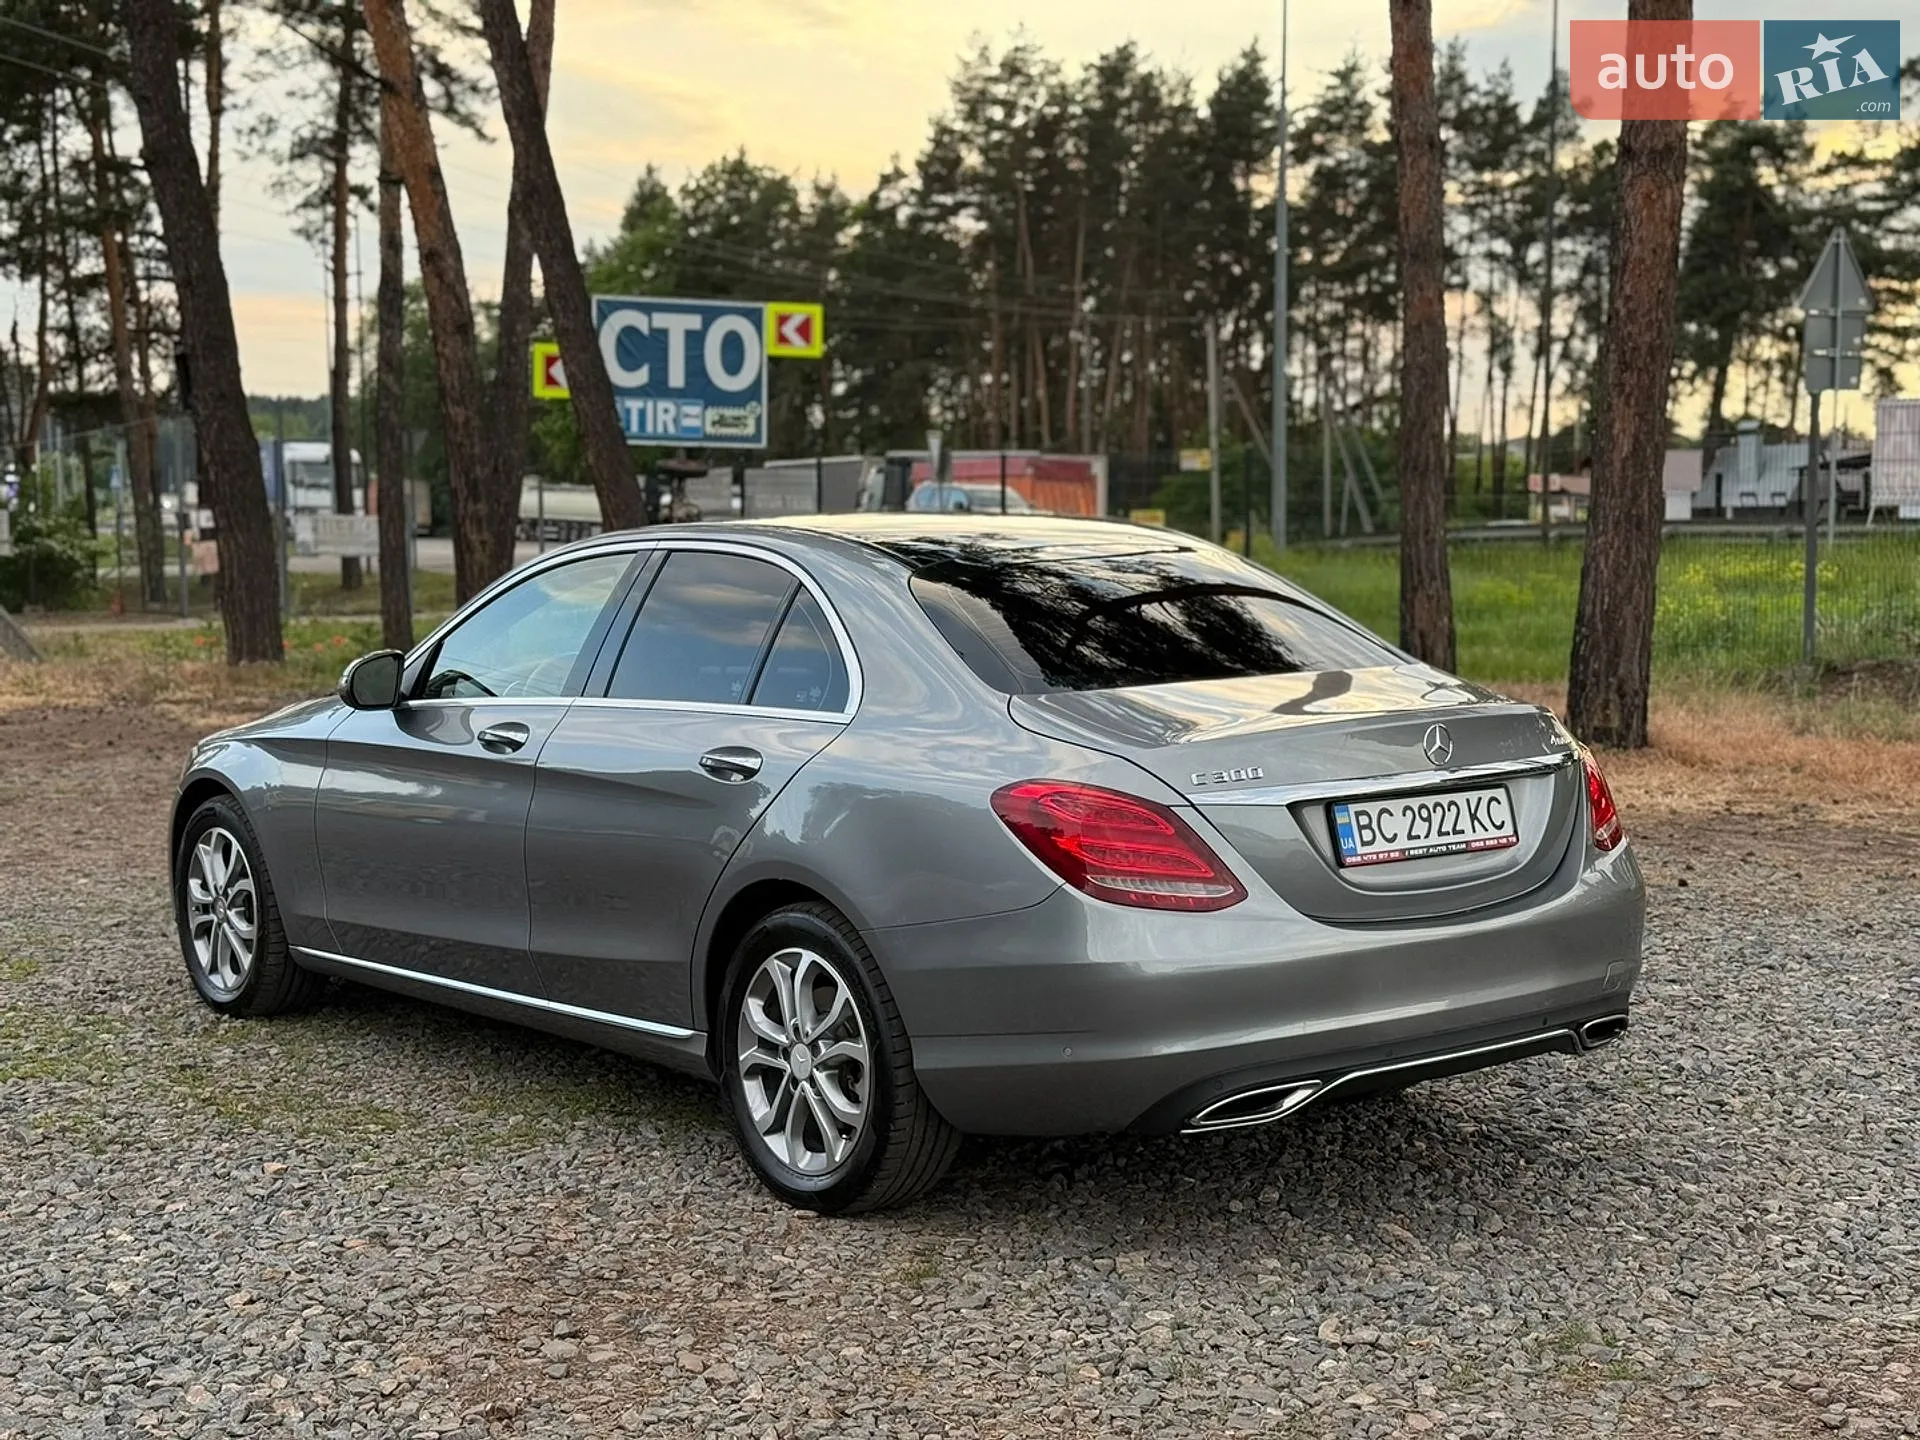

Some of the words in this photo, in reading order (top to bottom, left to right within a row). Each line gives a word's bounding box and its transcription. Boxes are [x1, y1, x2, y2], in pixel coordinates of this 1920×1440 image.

[598, 308, 760, 392] СТО
[624, 399, 677, 435] TIR
[1190, 771, 1208, 786] C
[1211, 766, 1264, 783] 300
[1354, 807, 1398, 847] BC
[1401, 799, 1465, 841] 2922
[1466, 795, 1505, 833] KC
[1341, 837, 1355, 850] UA
